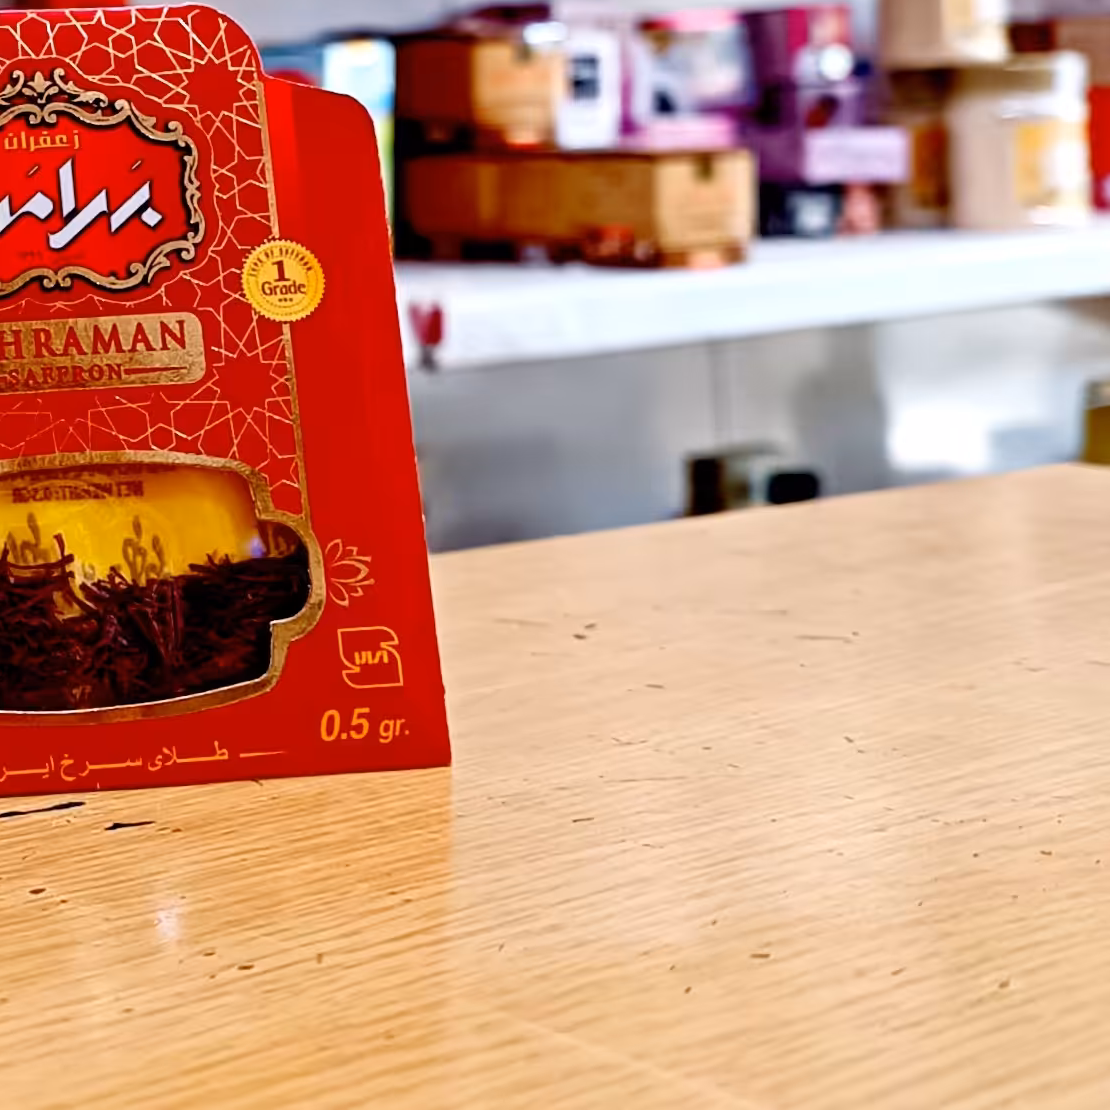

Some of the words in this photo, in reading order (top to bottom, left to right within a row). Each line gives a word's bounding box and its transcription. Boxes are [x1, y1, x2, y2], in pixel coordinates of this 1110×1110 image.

[3, 129, 81, 152] زعفران
[271, 259, 291, 282] 1
[261, 279, 307, 296] Grade
[7, 363, 124, 389] SAFFRON
[320, 707, 370, 742] 0.5
[378, 718, 410, 744] gr.
[59, 753, 143, 782] سرخ
[147, 740, 229, 771] طلای
